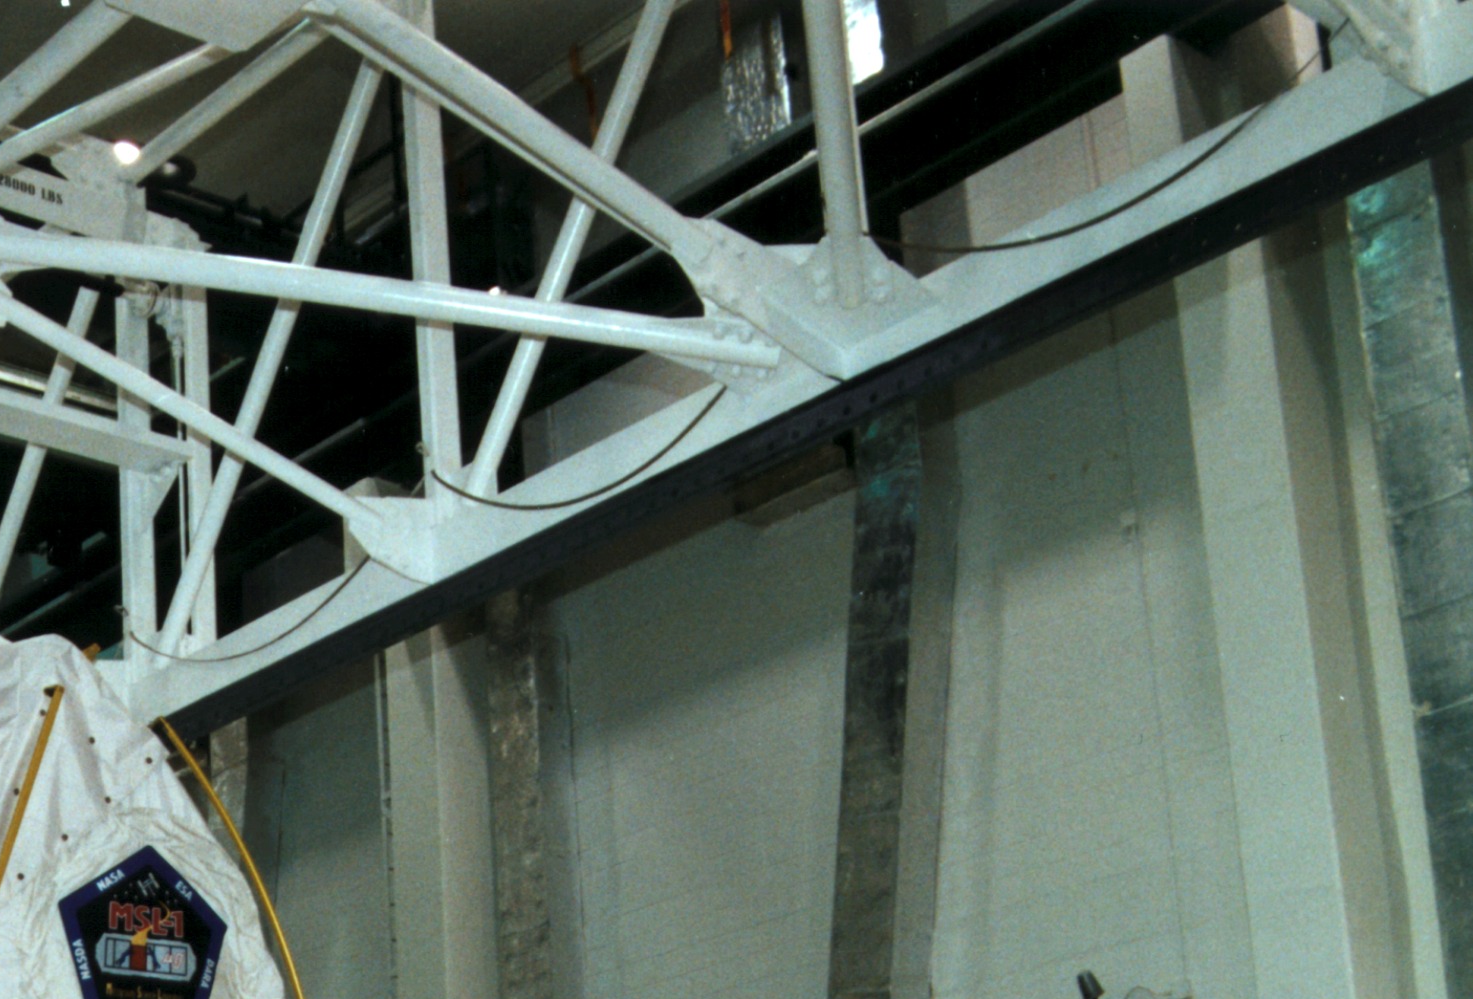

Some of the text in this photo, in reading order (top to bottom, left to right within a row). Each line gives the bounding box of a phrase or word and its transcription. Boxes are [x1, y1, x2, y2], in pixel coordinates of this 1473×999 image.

[41, 187, 64, 205] LBS
[96, 869, 126, 892] NASA
[175, 880, 193, 902] ESA
[108, 900, 185, 939] MSL-1
[71, 938, 92, 980] NASDA
[200, 957, 215, 989] DARA
